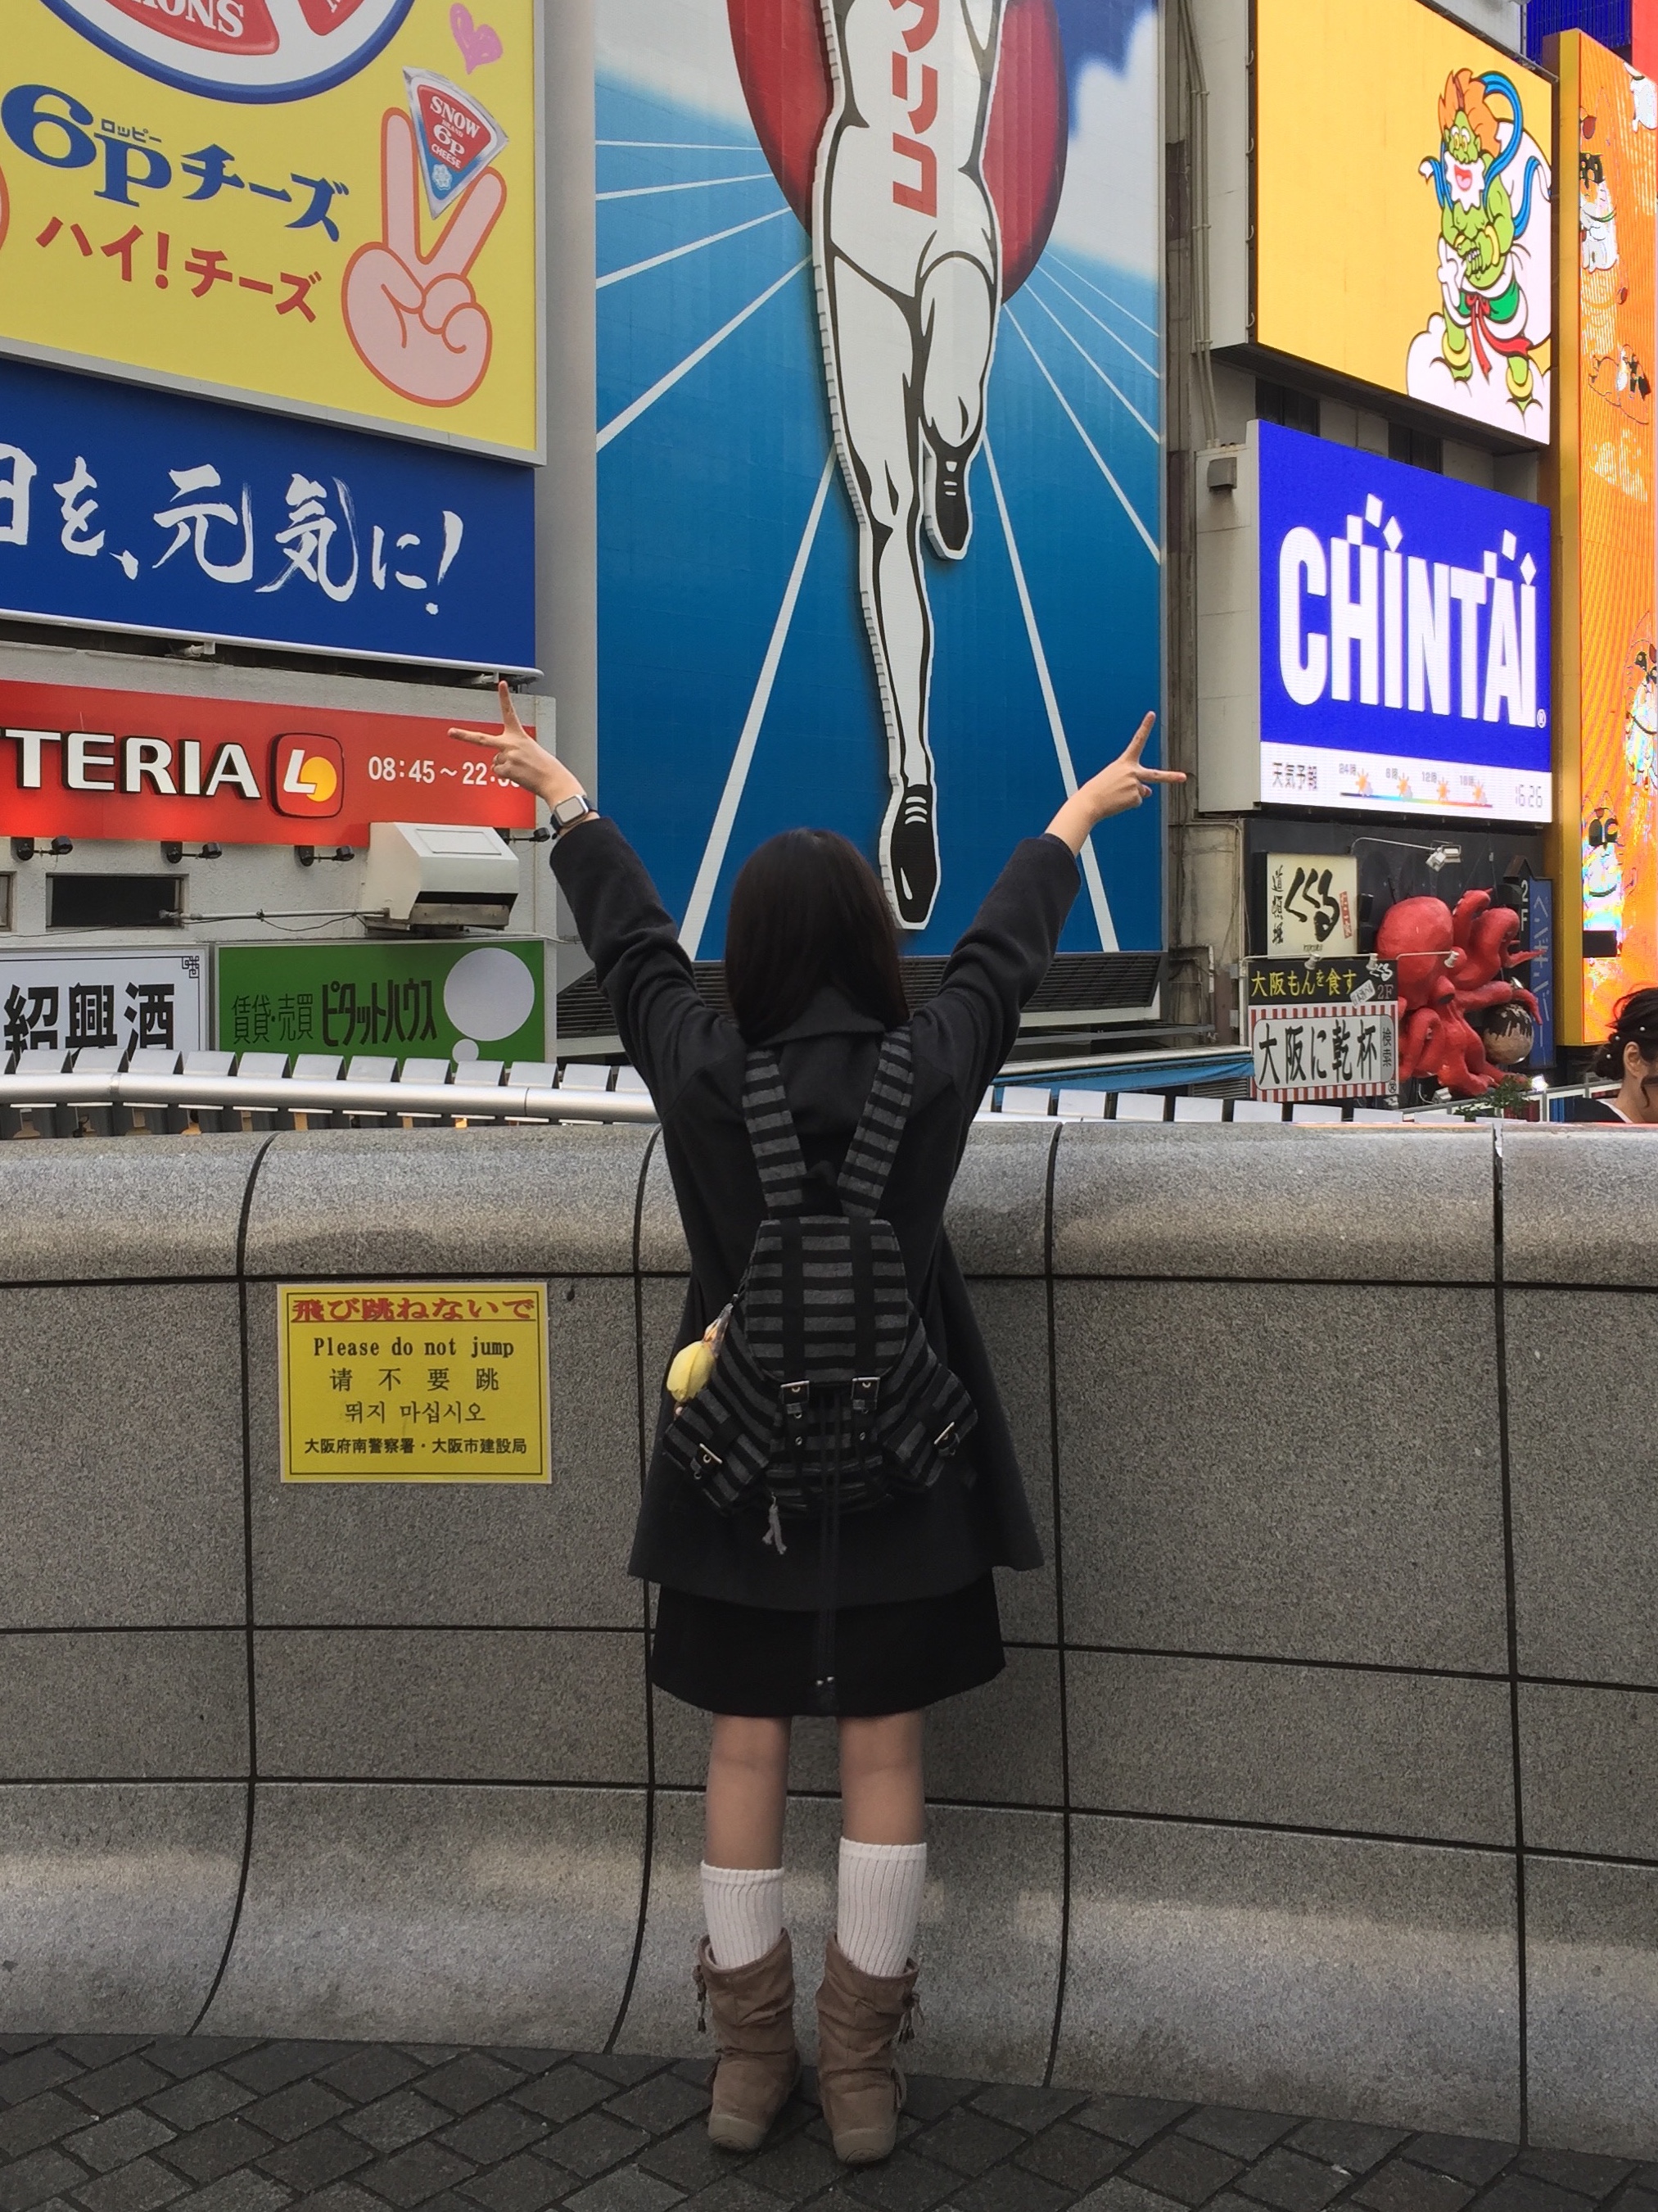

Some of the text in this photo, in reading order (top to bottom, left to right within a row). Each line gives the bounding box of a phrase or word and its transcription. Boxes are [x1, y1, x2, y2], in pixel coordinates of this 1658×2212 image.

[102, 118, 161, 143] ロッピー
[430, 96, 481, 138] SNOW
[431, 143, 461, 169] CHEESE
[1279, 493, 1537, 728] CHINTAI
[5, 729, 261, 798] TERIA
[1284, 866, 1340, 943] くくる
[1250, 968, 1358, 997] 大阪もんを食す
[1377, 984, 1394, 1000] 2F
[3, 982, 174, 1063] 紹興酒
[233, 977, 437, 1047] 賃貸・売買 ピタットハウス
[1258, 1019, 1377, 1085] 大阪に乾杯
[291, 1297, 535, 1321] 飛び跳ねないで
[314, 1337, 514, 1358] Please do not jump
[345, 1400, 486, 1424] 뛰지 마십시오
[305, 1438, 526, 1454] 大阪府南警察署・大阪市建設局
